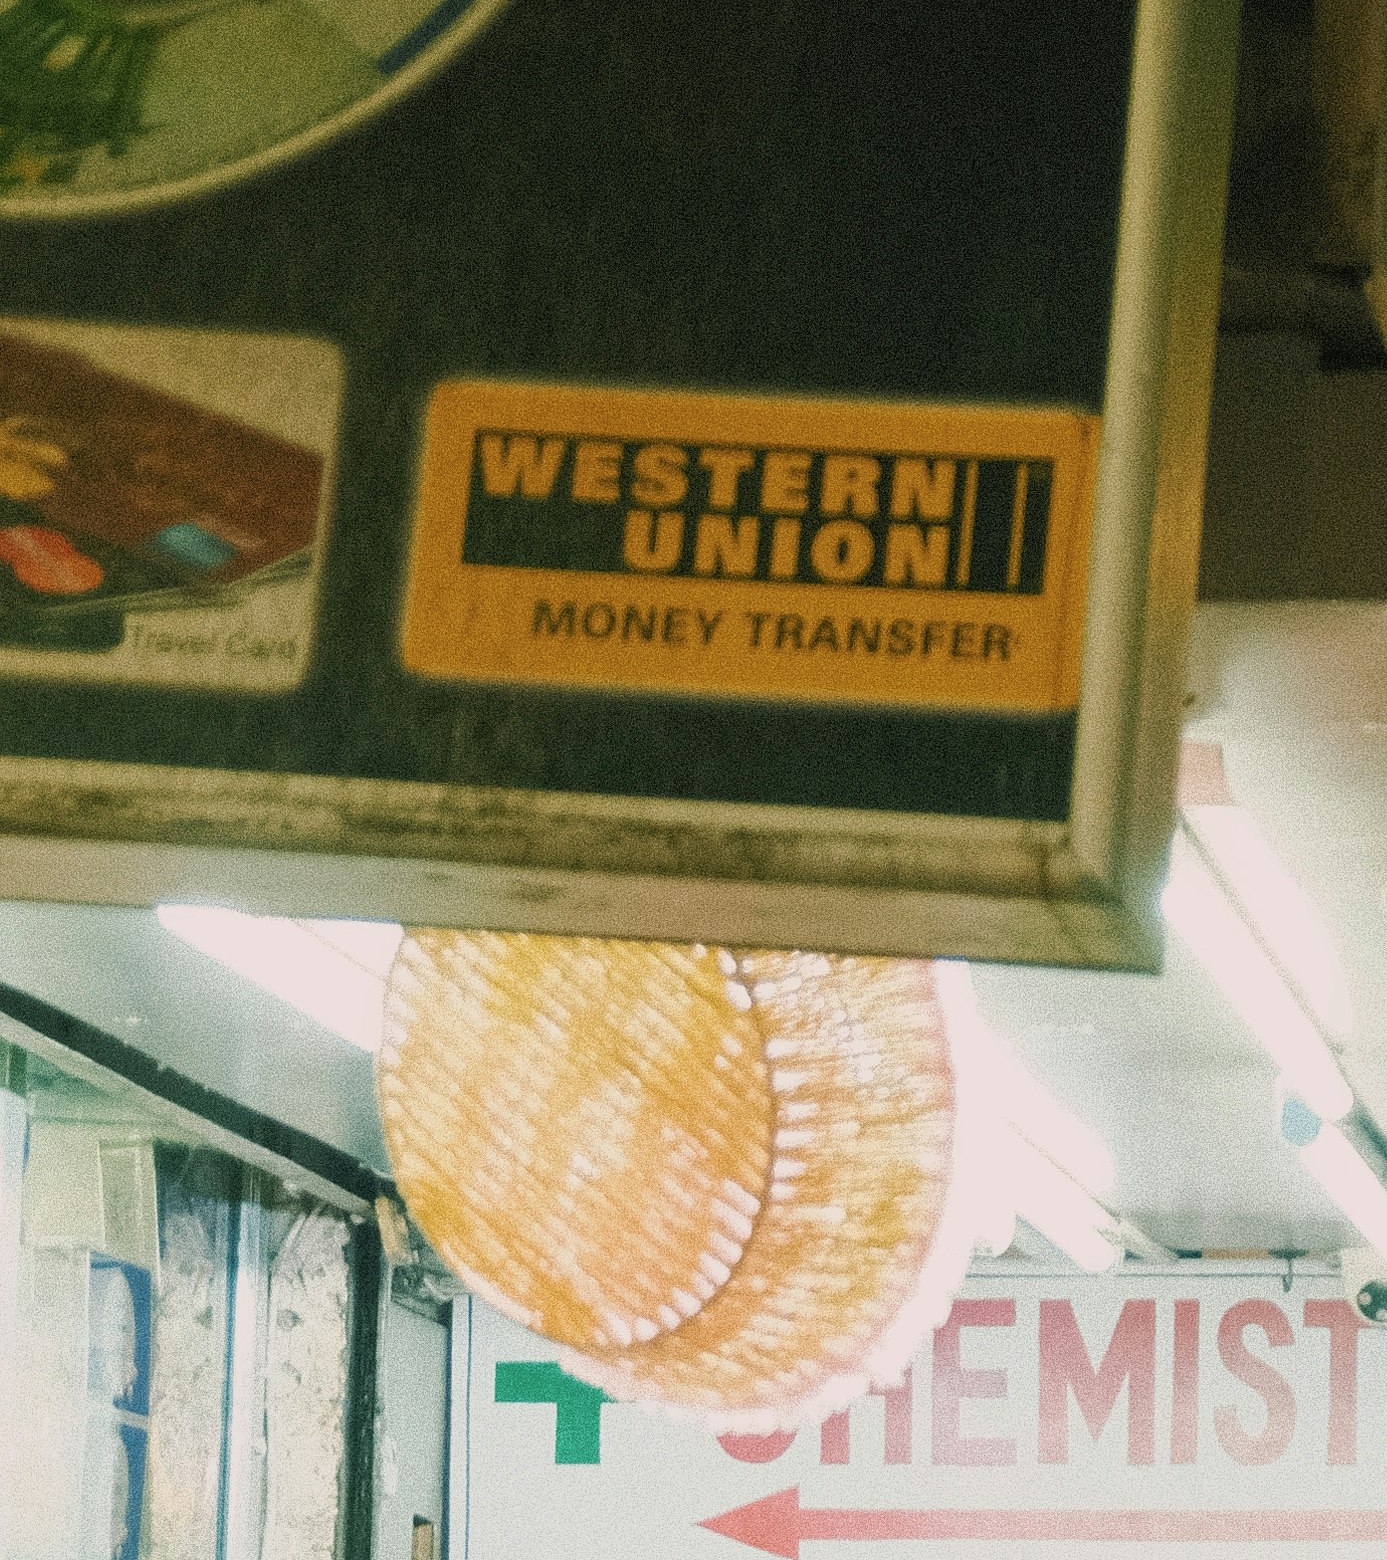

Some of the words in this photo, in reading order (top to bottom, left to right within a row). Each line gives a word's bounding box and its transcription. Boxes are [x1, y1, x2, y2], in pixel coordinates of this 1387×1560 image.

[479, 436, 957, 520] WESTERN
[624, 509, 952, 587] UNION
[532, 599, 721, 646] MONEY
[747, 610, 1013, 662] TRANSFER
[716, 1298, 1375, 1467] EMIST
